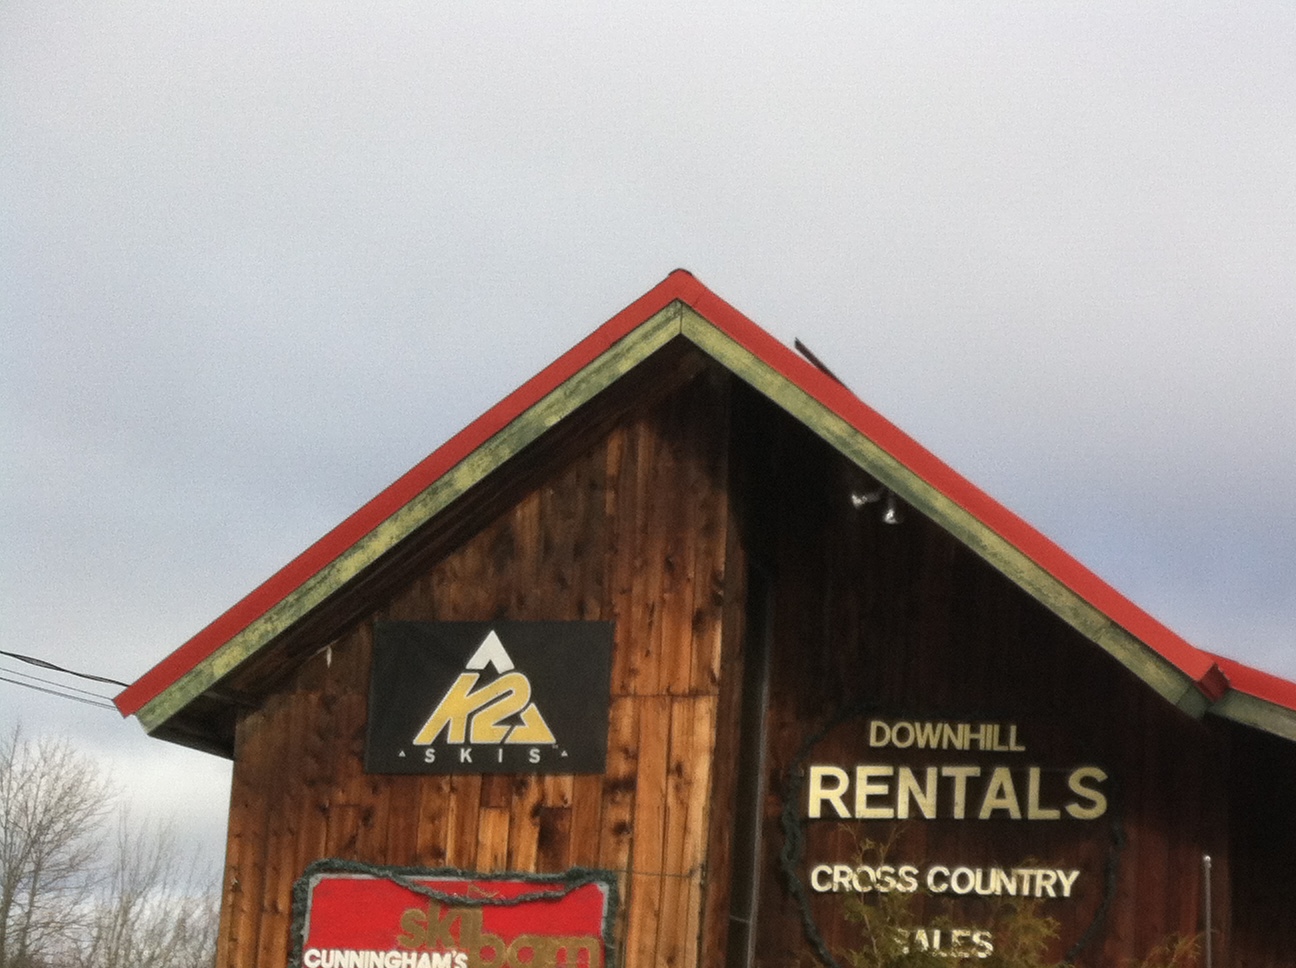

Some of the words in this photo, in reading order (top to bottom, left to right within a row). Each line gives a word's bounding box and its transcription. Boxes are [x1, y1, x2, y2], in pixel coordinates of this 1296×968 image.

[869, 720, 1026, 751] DOWNHILL
[424, 748, 541, 764] SKIS
[808, 765, 1108, 820] RENTALS
[810, 865, 919, 894] CROSS
[927, 865, 1080, 898] COUNTRY
